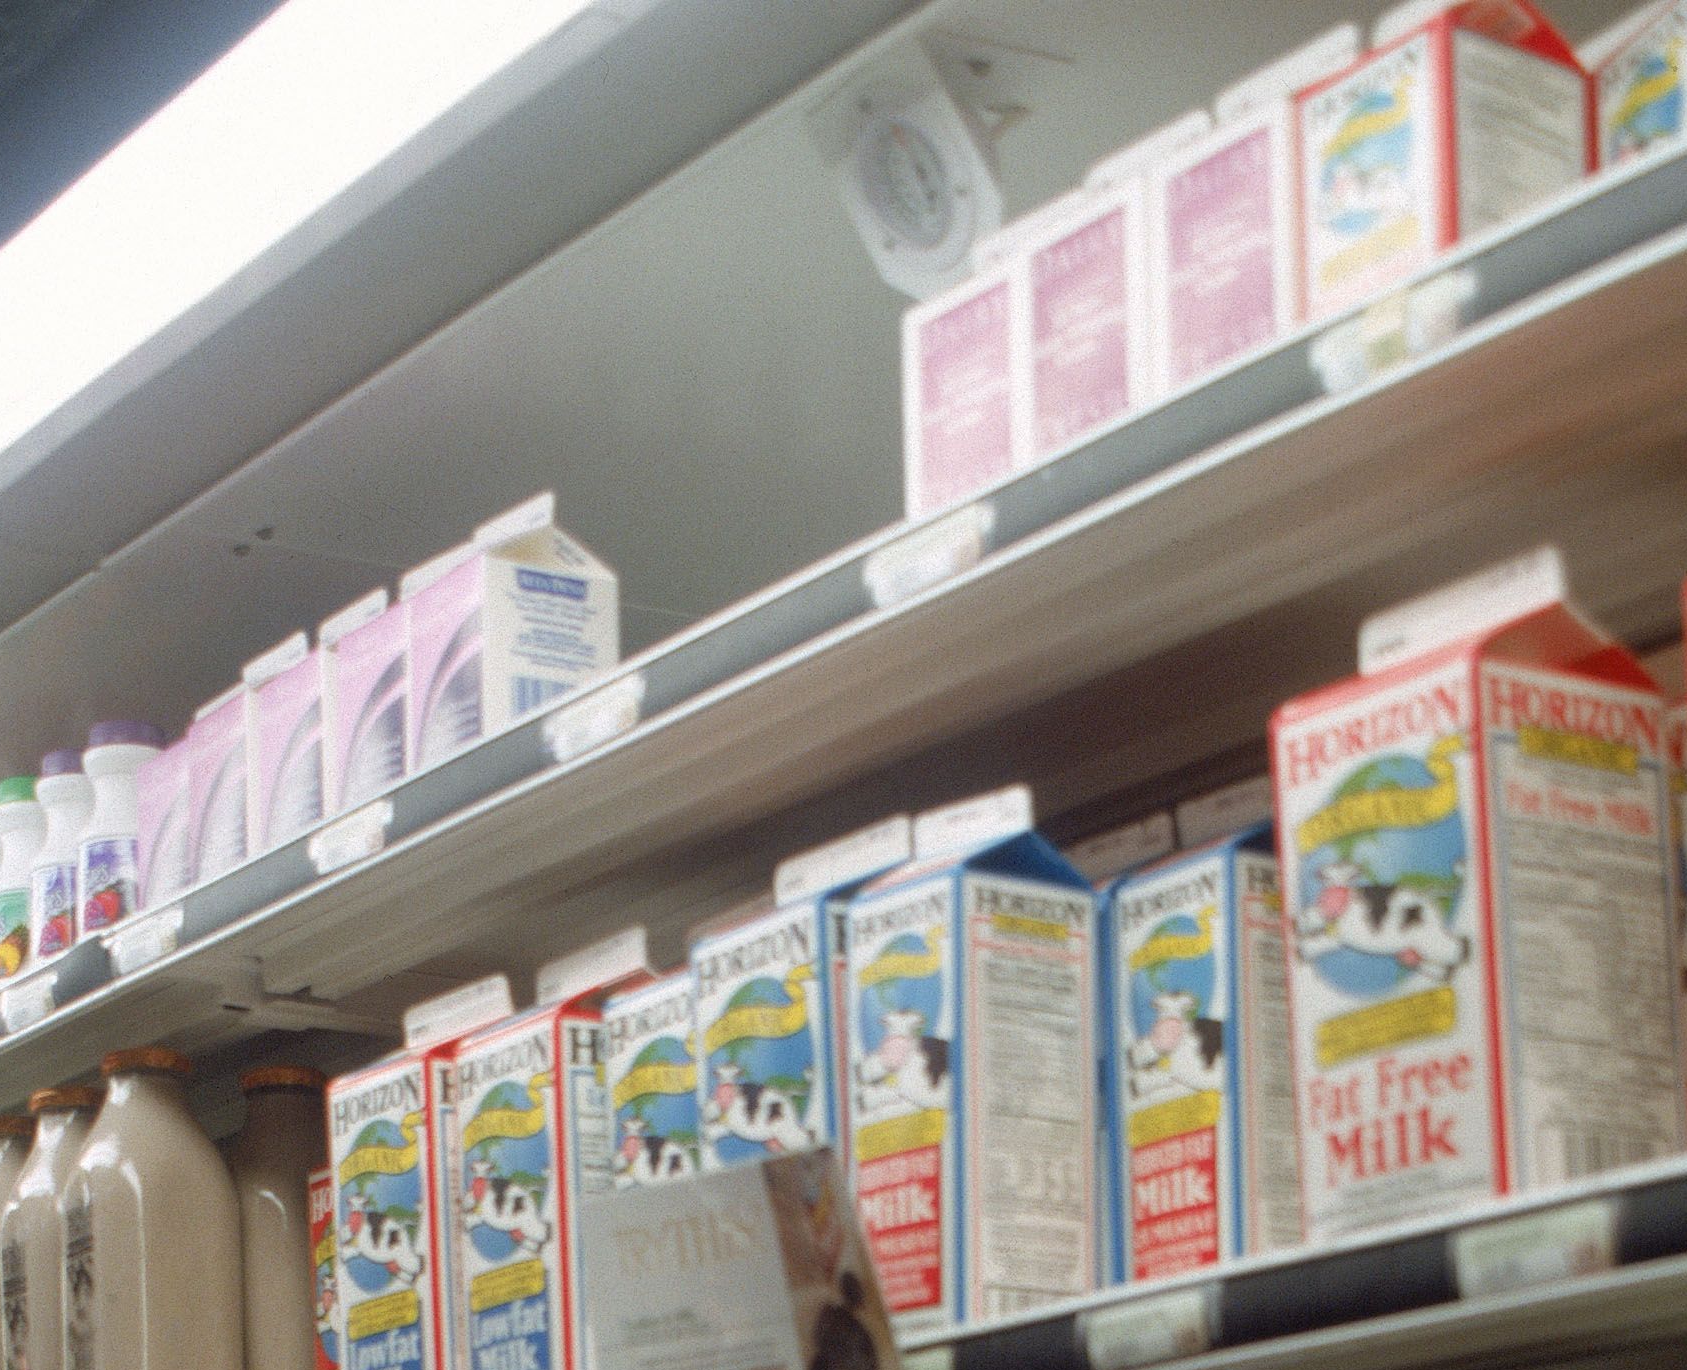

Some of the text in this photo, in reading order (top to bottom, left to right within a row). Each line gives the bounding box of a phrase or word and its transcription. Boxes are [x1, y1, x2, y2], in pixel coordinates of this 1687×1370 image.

[1287, 680, 1463, 786] HORIZON
[1488, 676, 1662, 748] HORIZON
[854, 892, 948, 936] HORIZON
[1124, 873, 1218, 918] HORIZON
[697, 916, 811, 998] HORIZON
[609, 993, 695, 1056] HORIZO
[459, 1036, 553, 1104] HORIZON
[1376, 1050, 1473, 1102] Free
[333, 1072, 421, 1136] HORIZON
[1327, 1106, 1461, 1188] Milk
[1135, 1167, 1213, 1217] Milk
